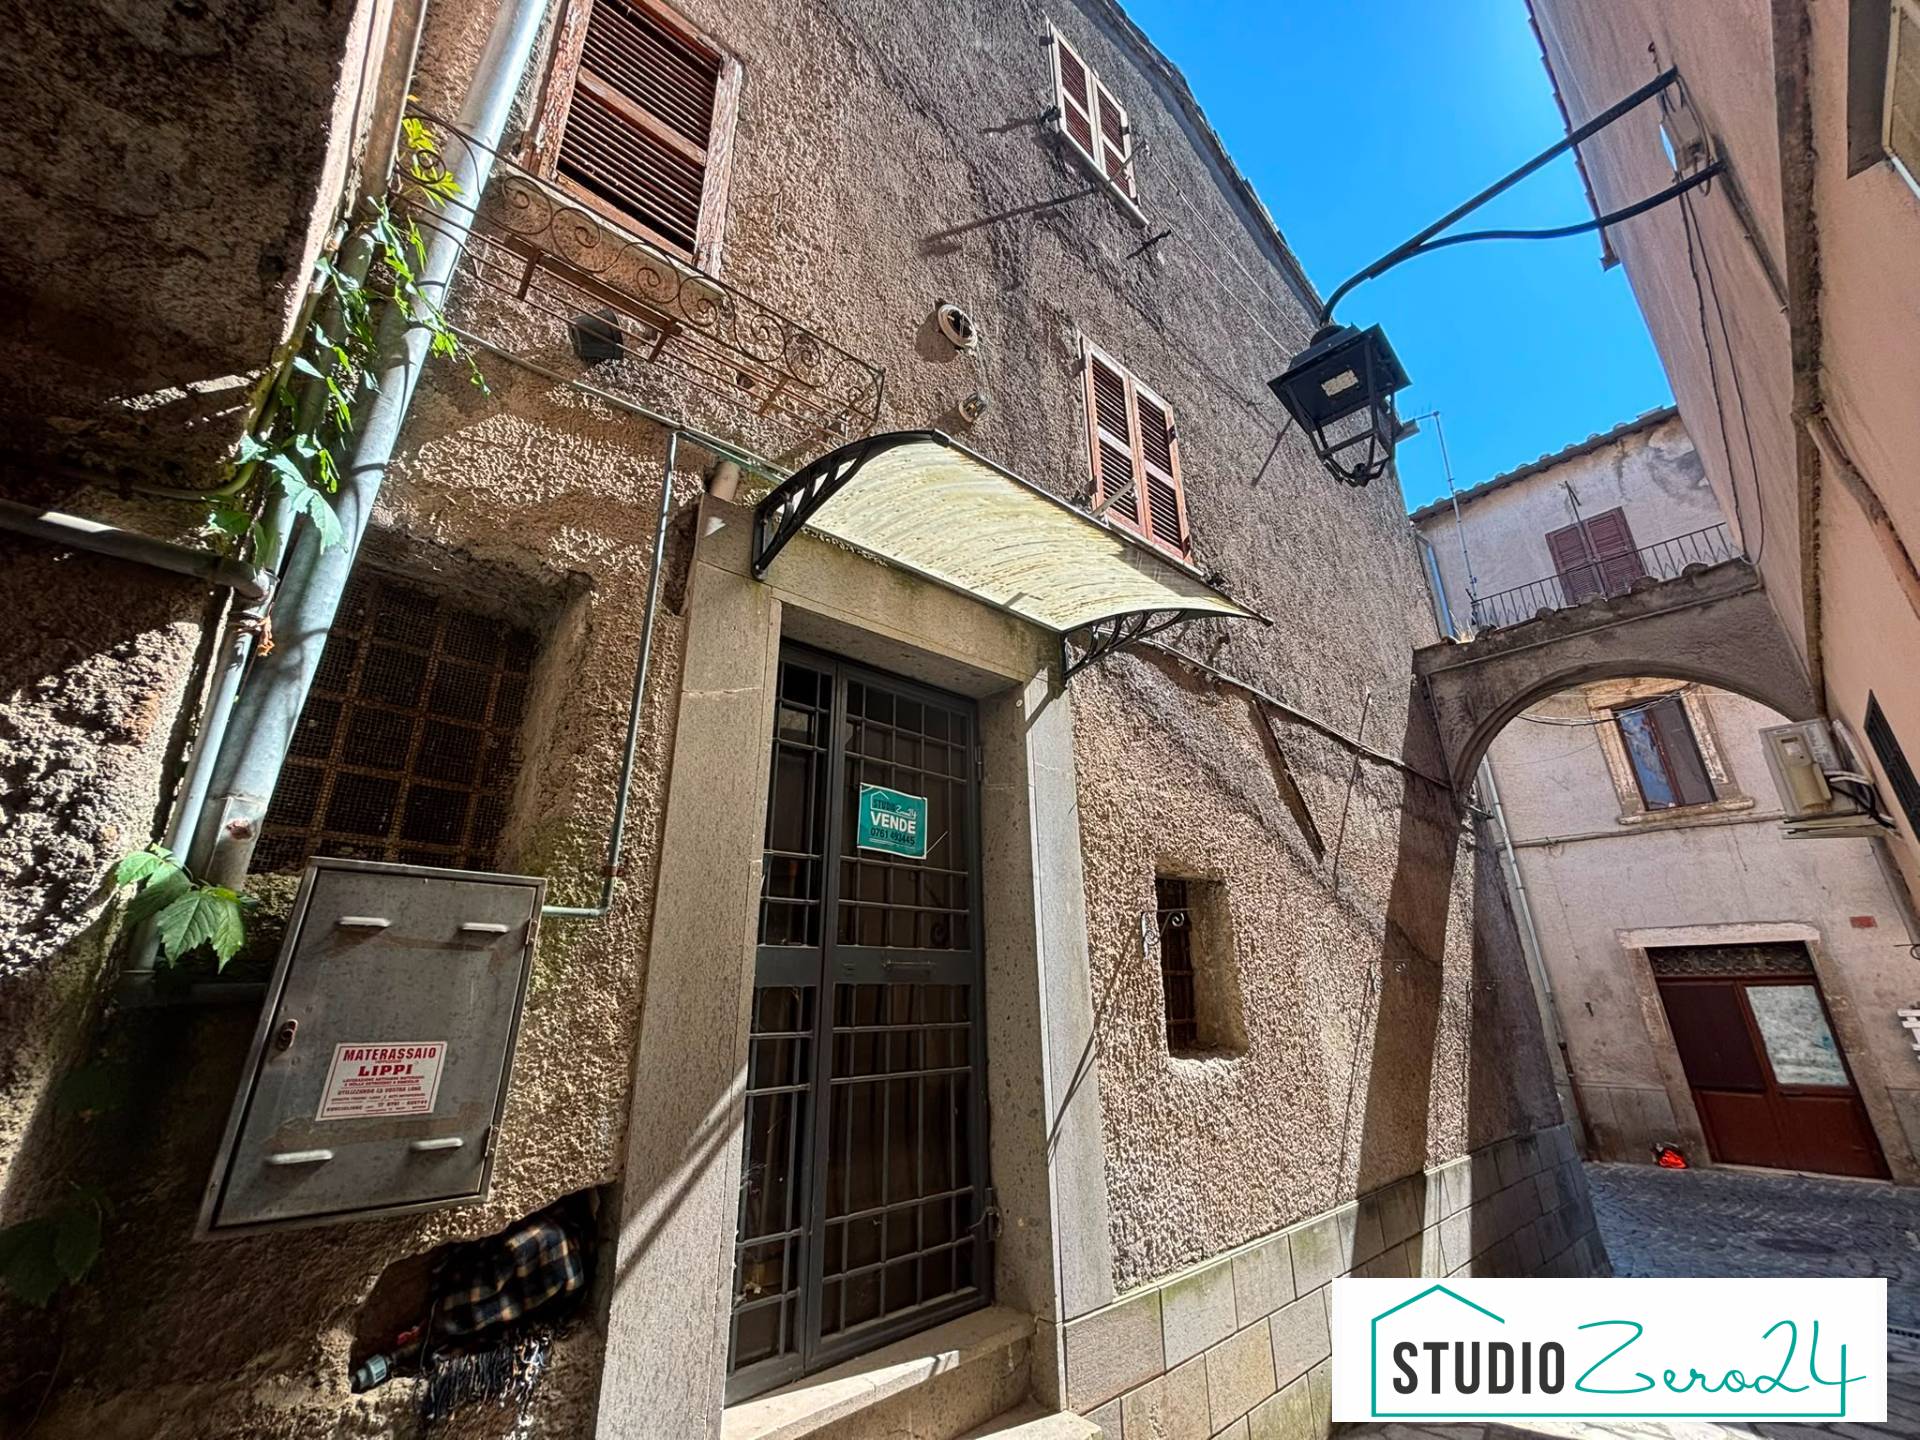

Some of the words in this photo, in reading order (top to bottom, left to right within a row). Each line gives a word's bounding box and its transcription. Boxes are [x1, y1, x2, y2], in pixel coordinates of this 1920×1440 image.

[871, 811, 916, 834] VENDE
[870, 827, 888, 838] 0761
[343, 1047, 437, 1061] MATERASSAIO
[358, 1064, 413, 1076] LIPPI
